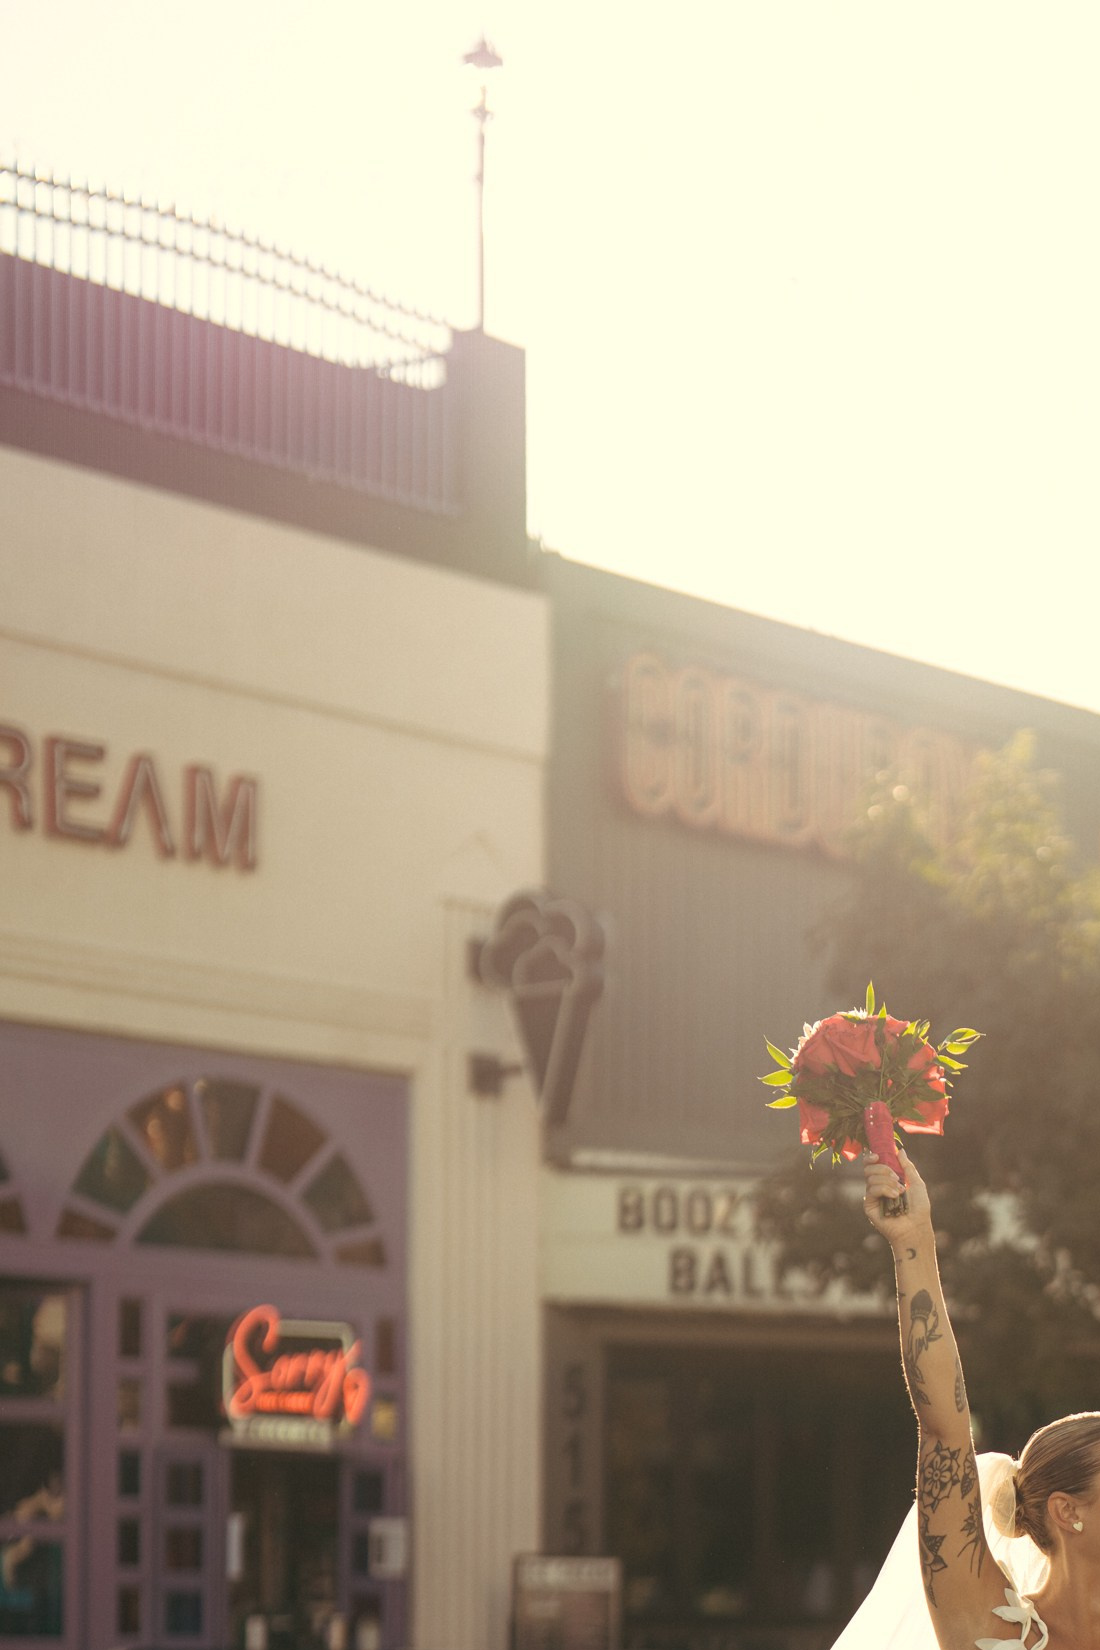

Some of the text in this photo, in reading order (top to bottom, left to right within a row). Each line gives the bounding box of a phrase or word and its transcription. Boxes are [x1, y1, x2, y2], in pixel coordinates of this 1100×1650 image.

[622, 650, 968, 868] CORDURO
[618, 1185, 768, 1234] BOOZ
[226, 1303, 362, 1419] Sorry
